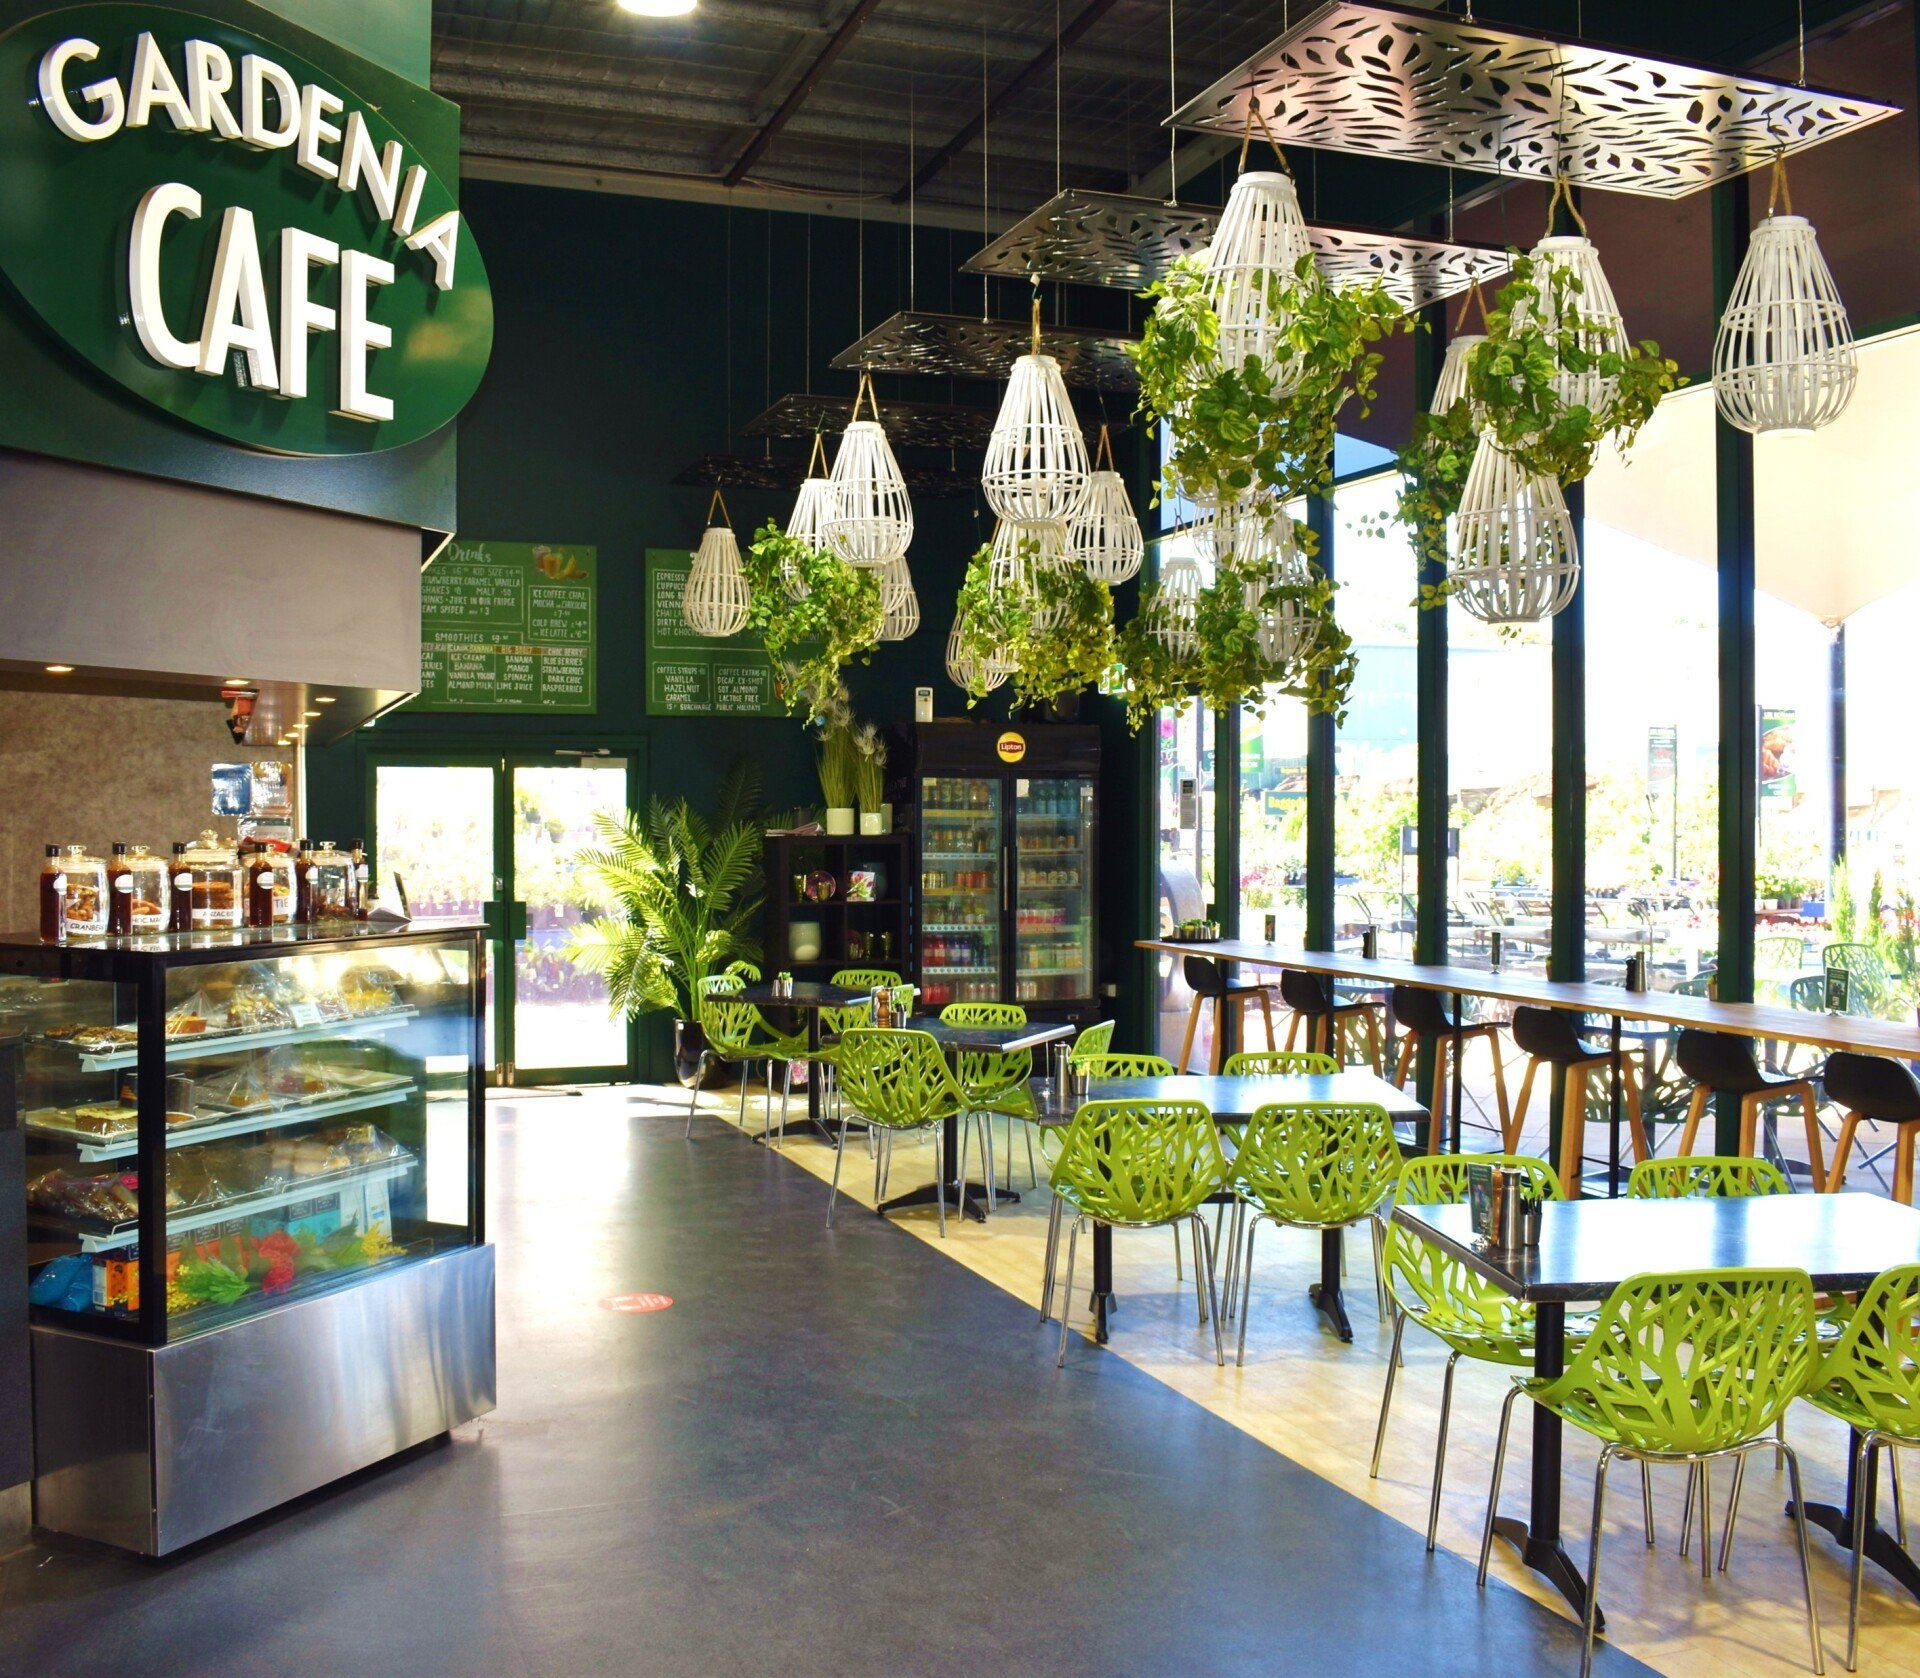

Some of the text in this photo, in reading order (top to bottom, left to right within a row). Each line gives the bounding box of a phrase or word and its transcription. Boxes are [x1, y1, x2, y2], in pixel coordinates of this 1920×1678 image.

[38, 32, 460, 291] GARDENIA
[128, 182, 395, 422] CAFE
[447, 543, 492, 563] Drinks
[657, 592, 675, 600] LONG
[656, 609, 672, 618] CHAI
[657, 619, 677, 627] DIRTY
[657, 627, 671, 636] HOT
[435, 633, 484, 643] SMOOTHIES
[463, 655, 487, 663] CREAM
[505, 655, 533, 664] BANANA
[543, 656, 583, 666] BLUEBERRIES
[506, 664, 530, 673] MANGO
[449, 672, 475, 680] VANILLA
[503, 673, 533, 682] SPINACH
[665, 676, 694, 684] VANILLA
[496, 682, 533, 691] LIME JUICE
[542, 683, 583, 693] RASPBERRIES
[664, 684, 700, 694] HAZELNUT
[665, 694, 691, 703] CARAMEL
[744, 695, 759, 703] FREE
[1001, 743, 1022, 751] Lipton
